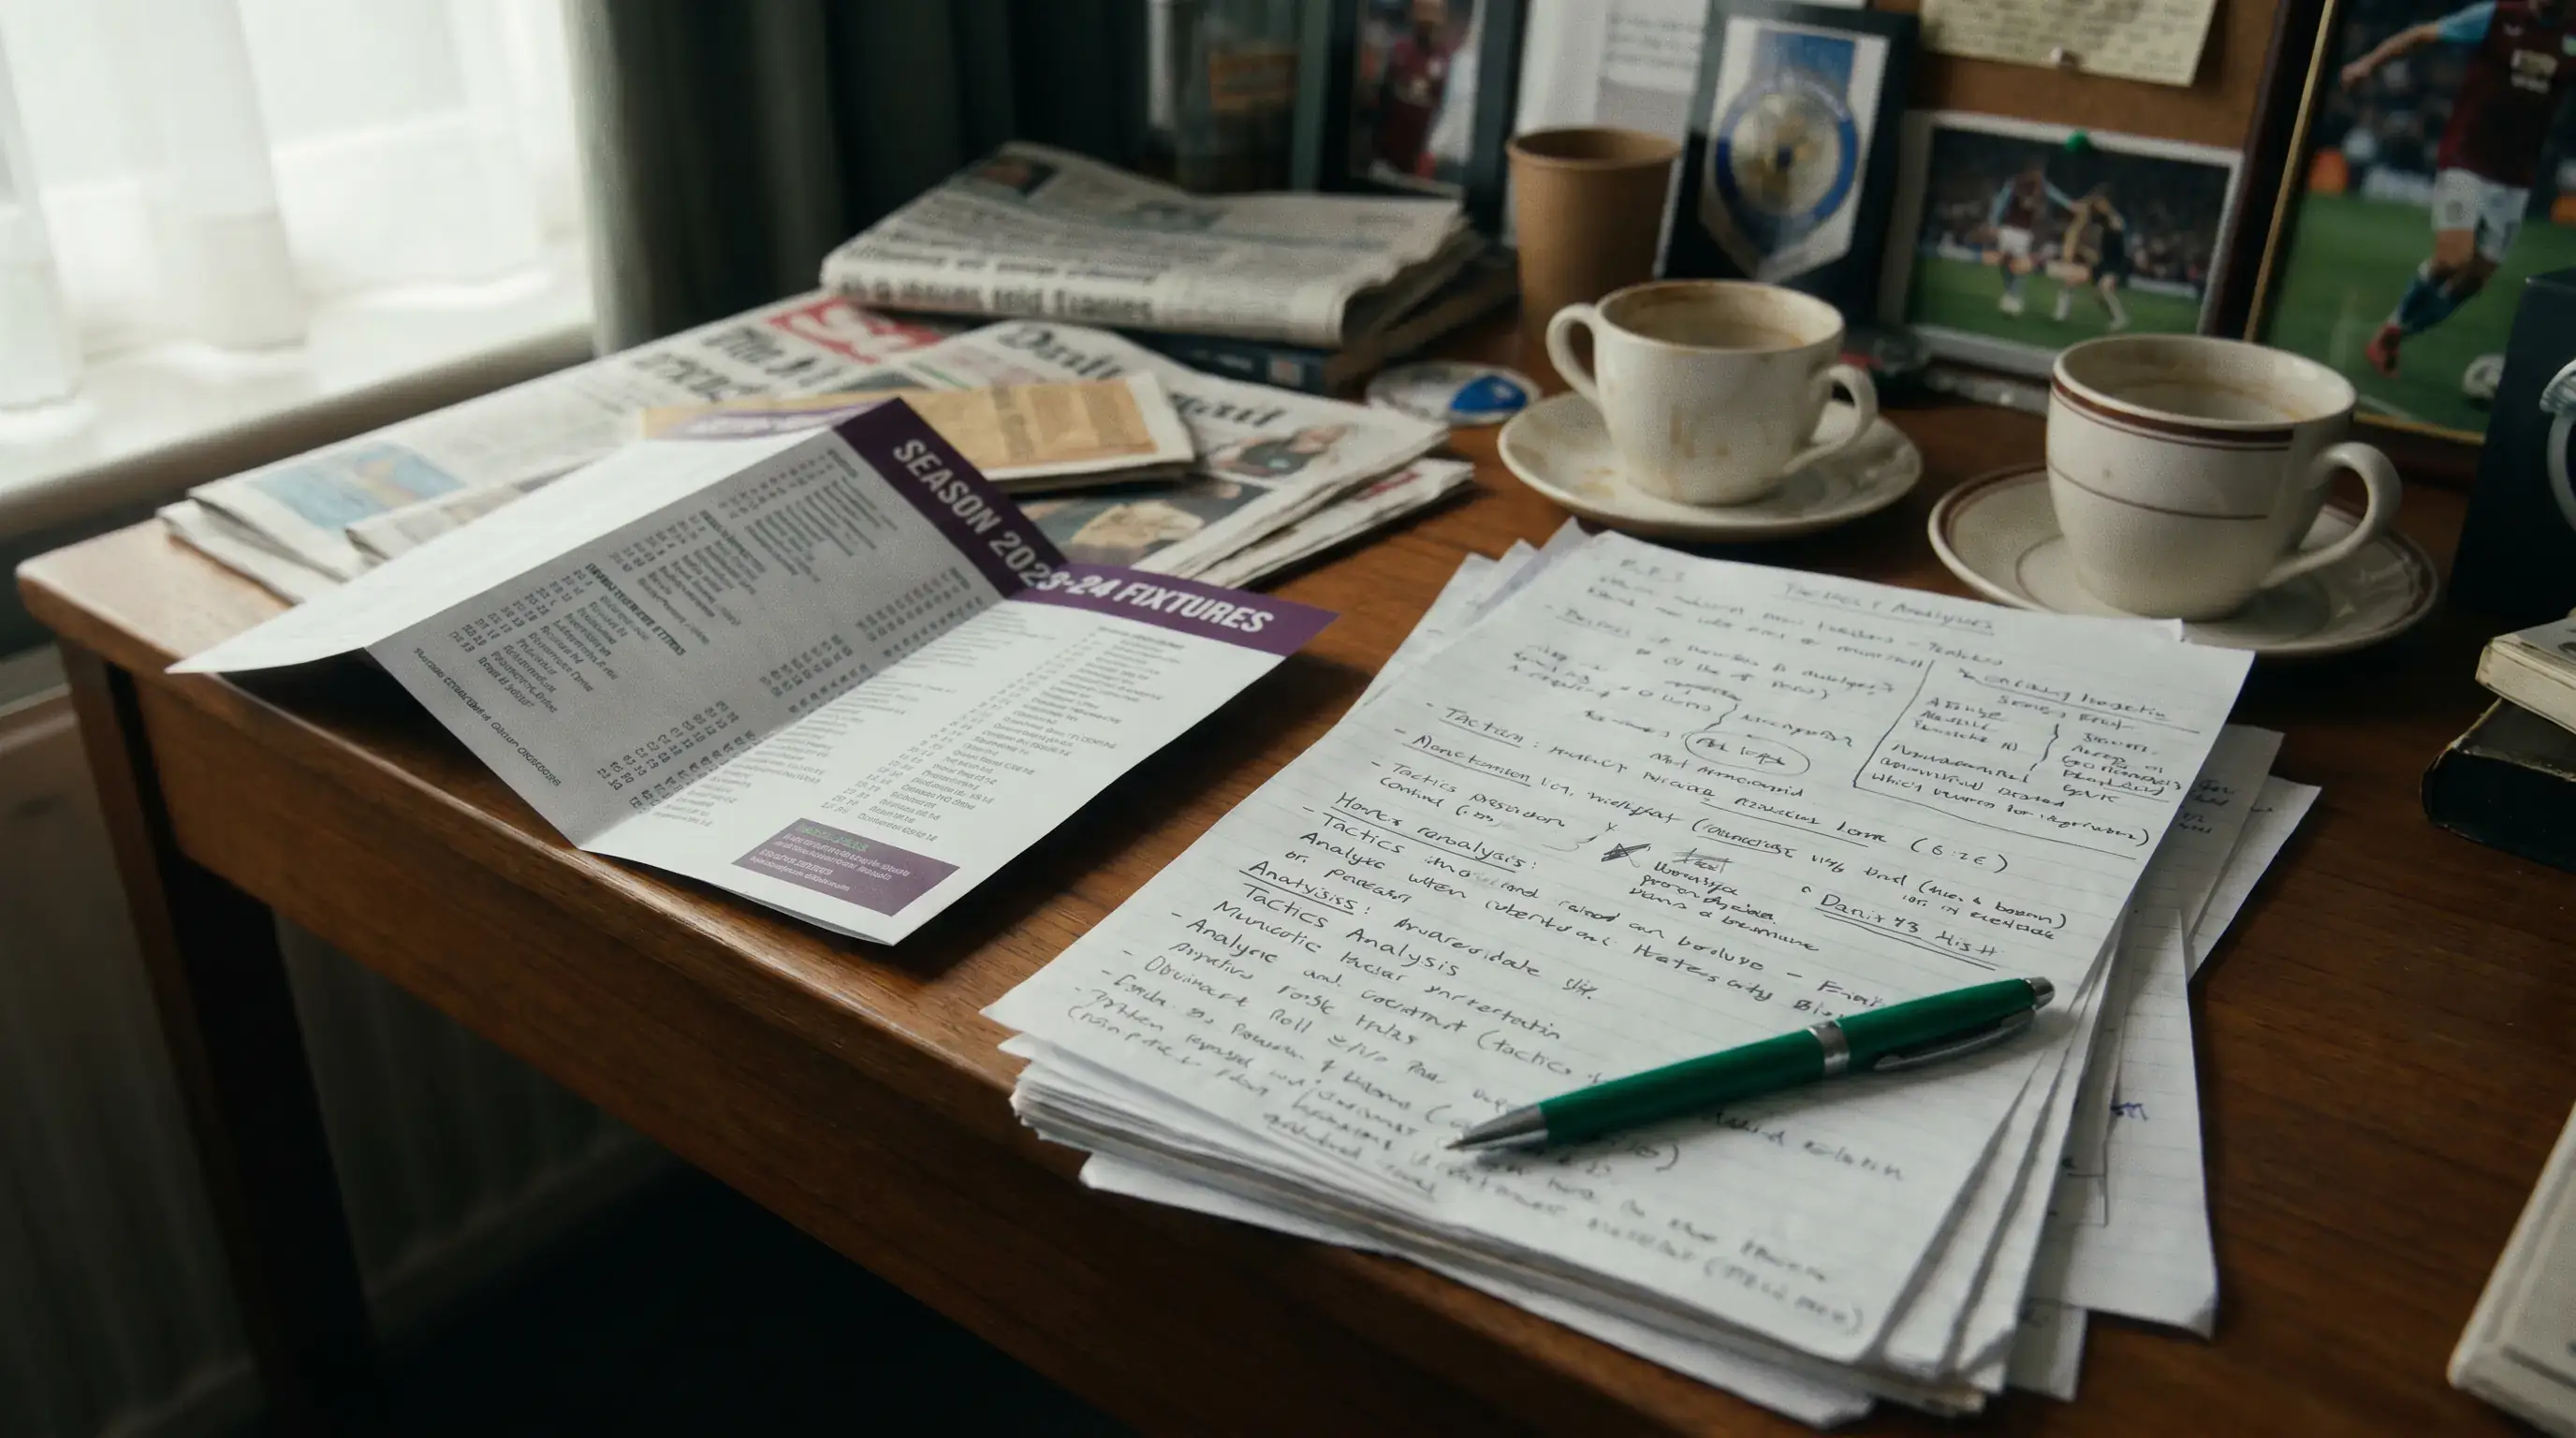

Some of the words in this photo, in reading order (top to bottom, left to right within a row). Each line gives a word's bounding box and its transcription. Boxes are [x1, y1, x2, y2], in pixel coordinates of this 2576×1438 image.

[893, 438, 1003, 535] SEASON
[989, 532, 1114, 599] 2023-24
[1114, 580, 1275, 635] FIXTURES
[1392, 762, 1457, 794] Tactics
[1322, 811, 1407, 855] Tactics
[1243, 883, 1329, 929] Tactics
[1345, 928, 1460, 976] Analysis
